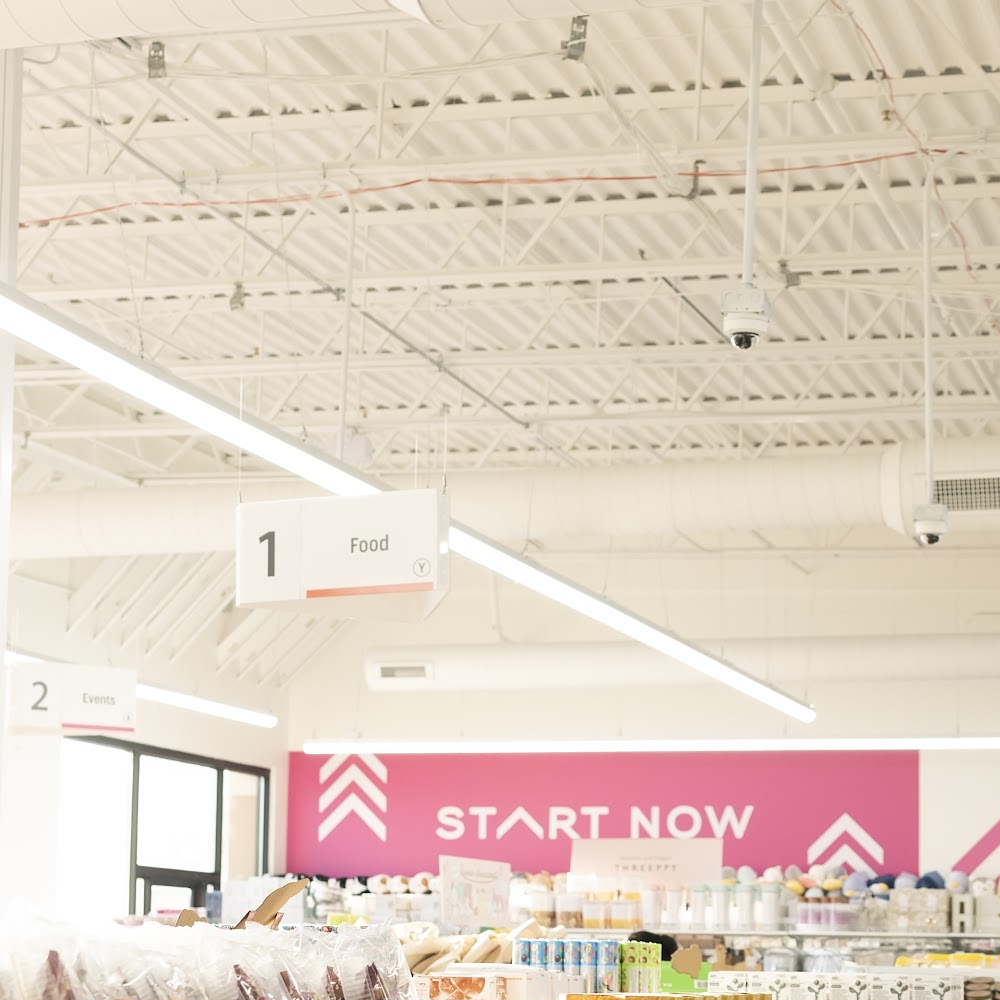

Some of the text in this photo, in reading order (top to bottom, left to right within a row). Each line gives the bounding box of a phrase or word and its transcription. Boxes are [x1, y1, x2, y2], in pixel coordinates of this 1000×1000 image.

[258, 531, 276, 577] 1
[350, 534, 389, 553] Food
[31, 681, 48, 711] 2
[82, 692, 116, 706] Events
[436, 805, 754, 840] START NOW
